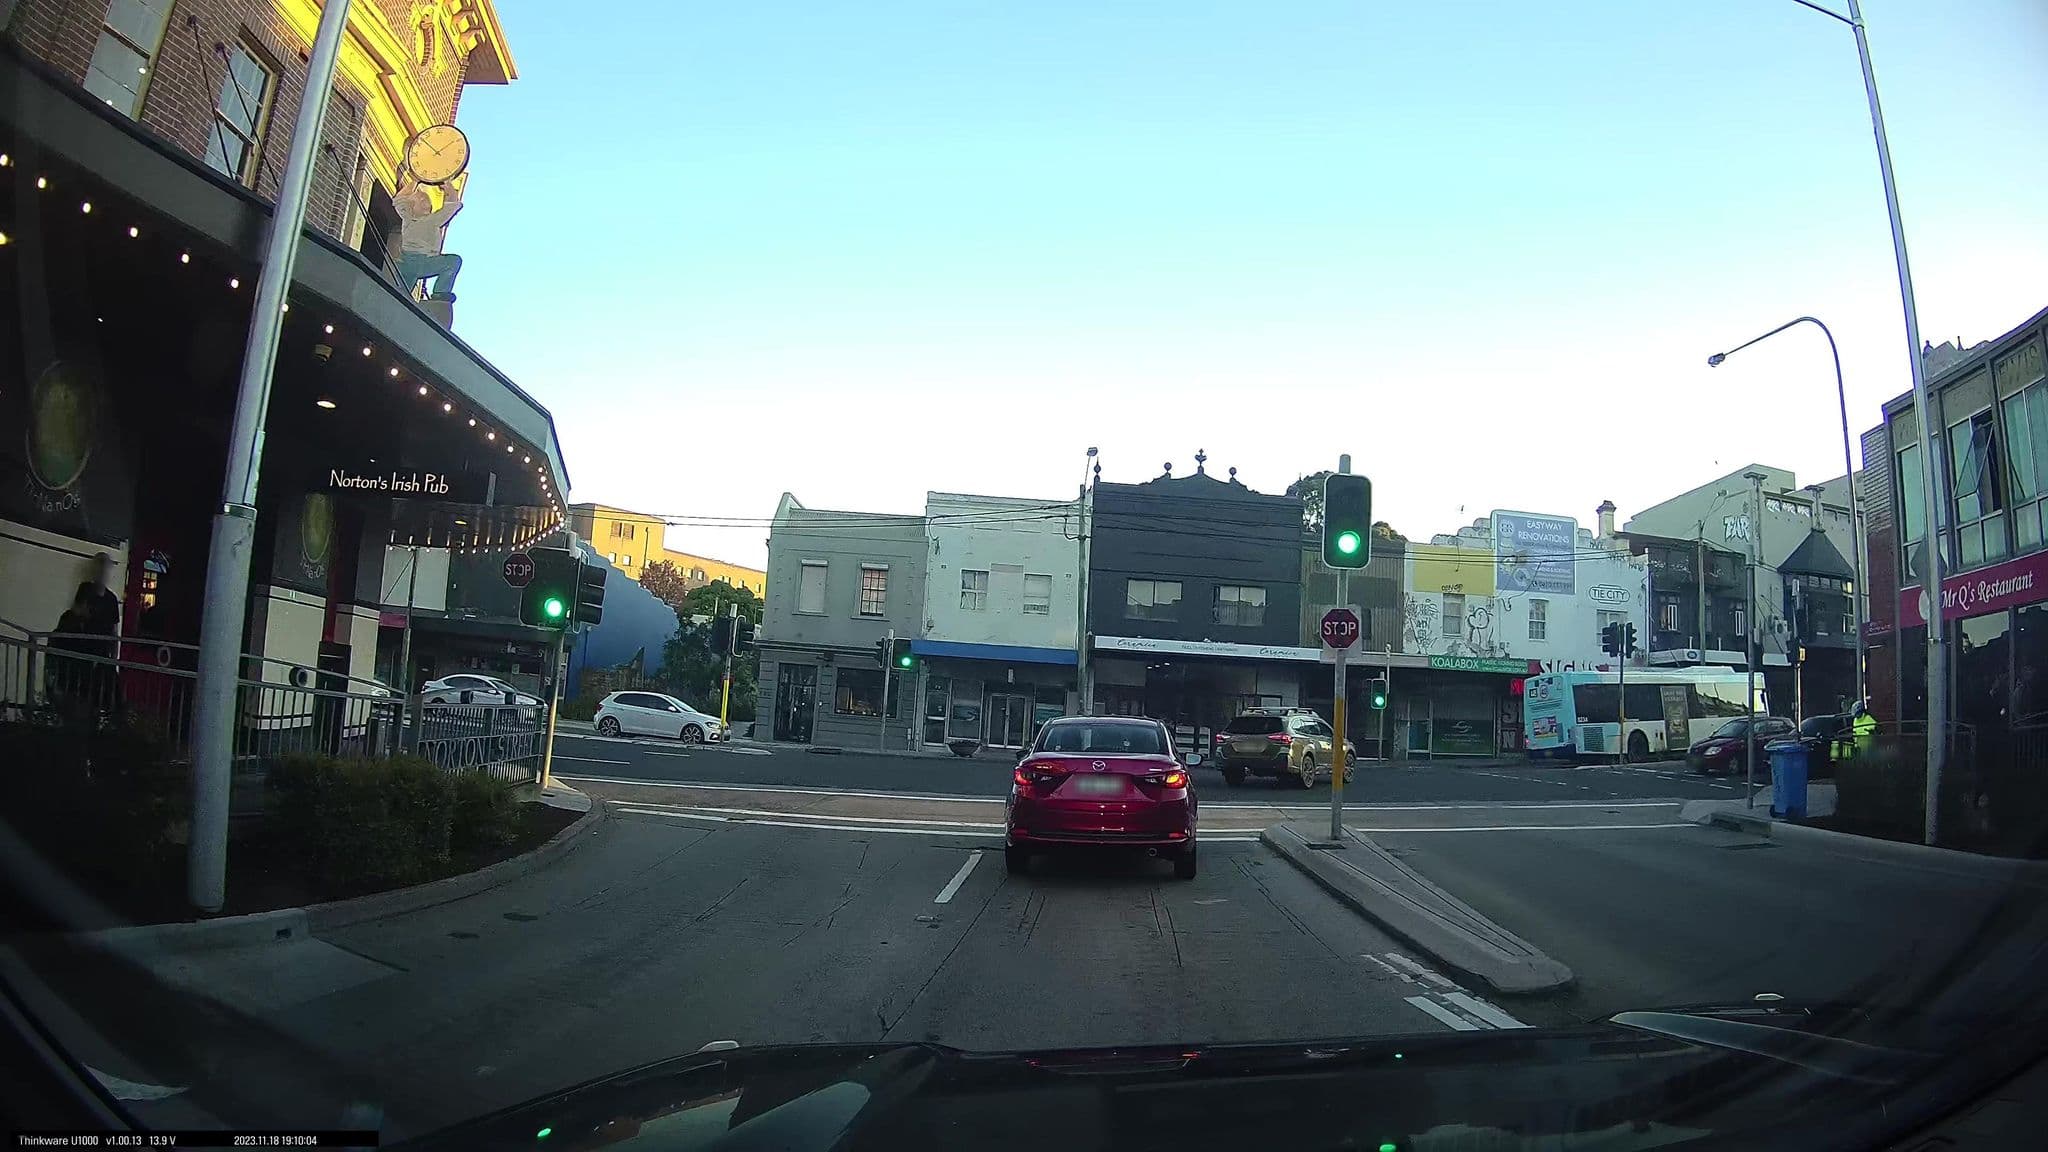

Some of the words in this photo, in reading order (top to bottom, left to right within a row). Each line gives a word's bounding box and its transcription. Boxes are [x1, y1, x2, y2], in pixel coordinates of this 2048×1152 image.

[329, 469, 388, 491] Norton's
[391, 472, 420, 492] Irish
[423, 473, 449, 494] Pub
[1526, 520, 1563, 531] EASYWAY
[1518, 531, 1570, 544] RENOVATIONS
[505, 563, 532, 576] STOP
[1592, 589, 1605, 599] TIE
[1606, 590, 1627, 600] CITY
[1942, 590, 1957, 609] Mr
[1958, 580, 1975, 611] Q's
[1977, 570, 2034, 603] Restaurant
[1323, 621, 1357, 636] STOP
[1431, 657, 1479, 670] KOALABOX
[424, 736, 486, 770] NORTON
[498, 731, 534, 763] STREET
